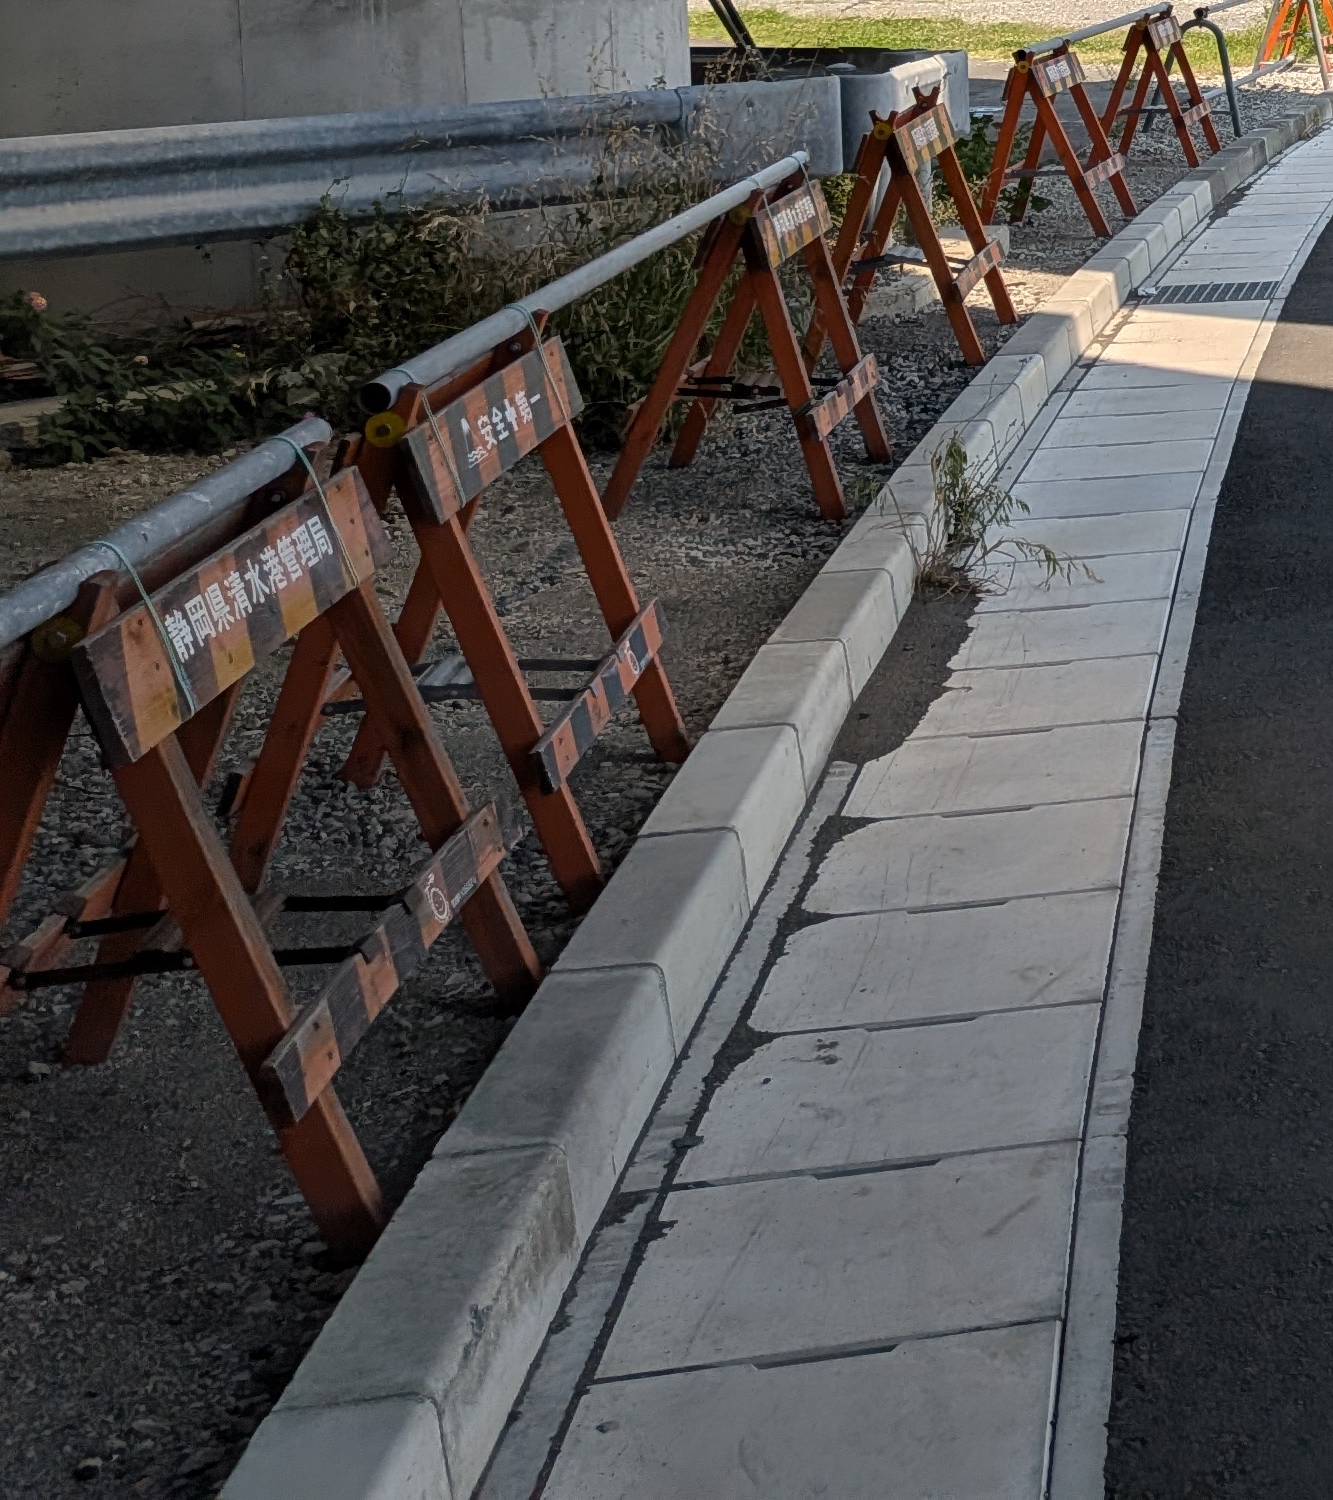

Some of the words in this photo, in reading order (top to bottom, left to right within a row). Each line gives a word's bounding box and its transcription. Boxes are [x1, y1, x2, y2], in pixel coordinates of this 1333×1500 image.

[164, 514, 334, 664] 静岡県清水港管理局
